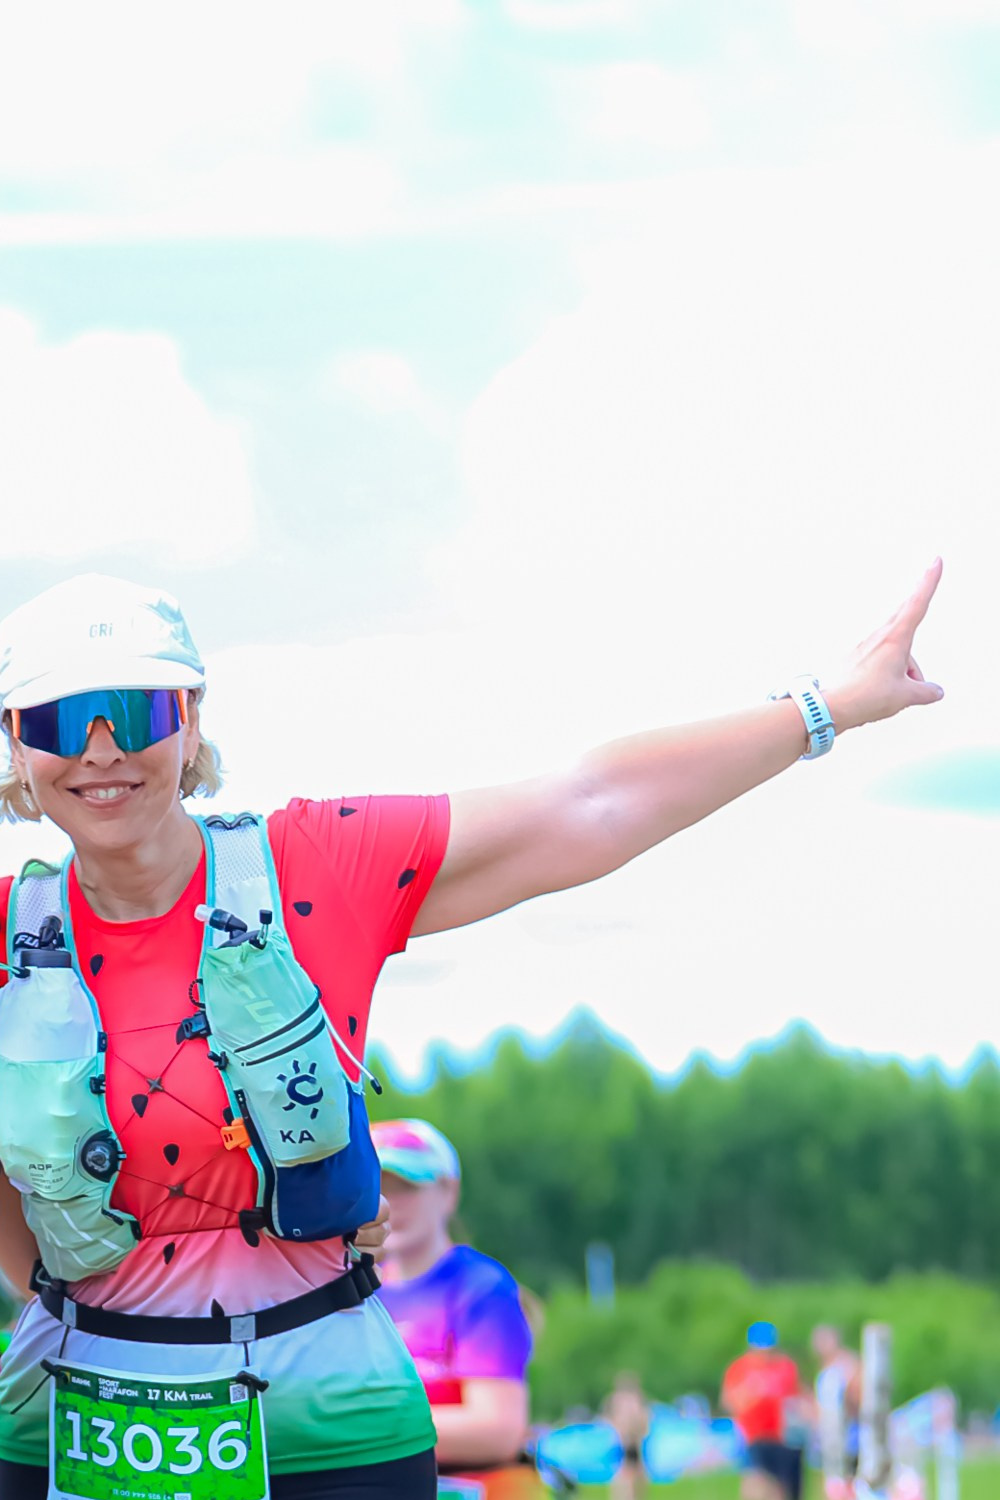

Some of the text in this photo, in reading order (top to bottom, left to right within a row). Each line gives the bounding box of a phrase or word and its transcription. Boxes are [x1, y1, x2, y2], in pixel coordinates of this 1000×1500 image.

[279, 1130, 316, 1144] KA
[99, 1390, 114, 1399] FEST
[147, 1388, 213, 1401] 17 KM TRAIL
[65, 1410, 248, 1475] 13036
